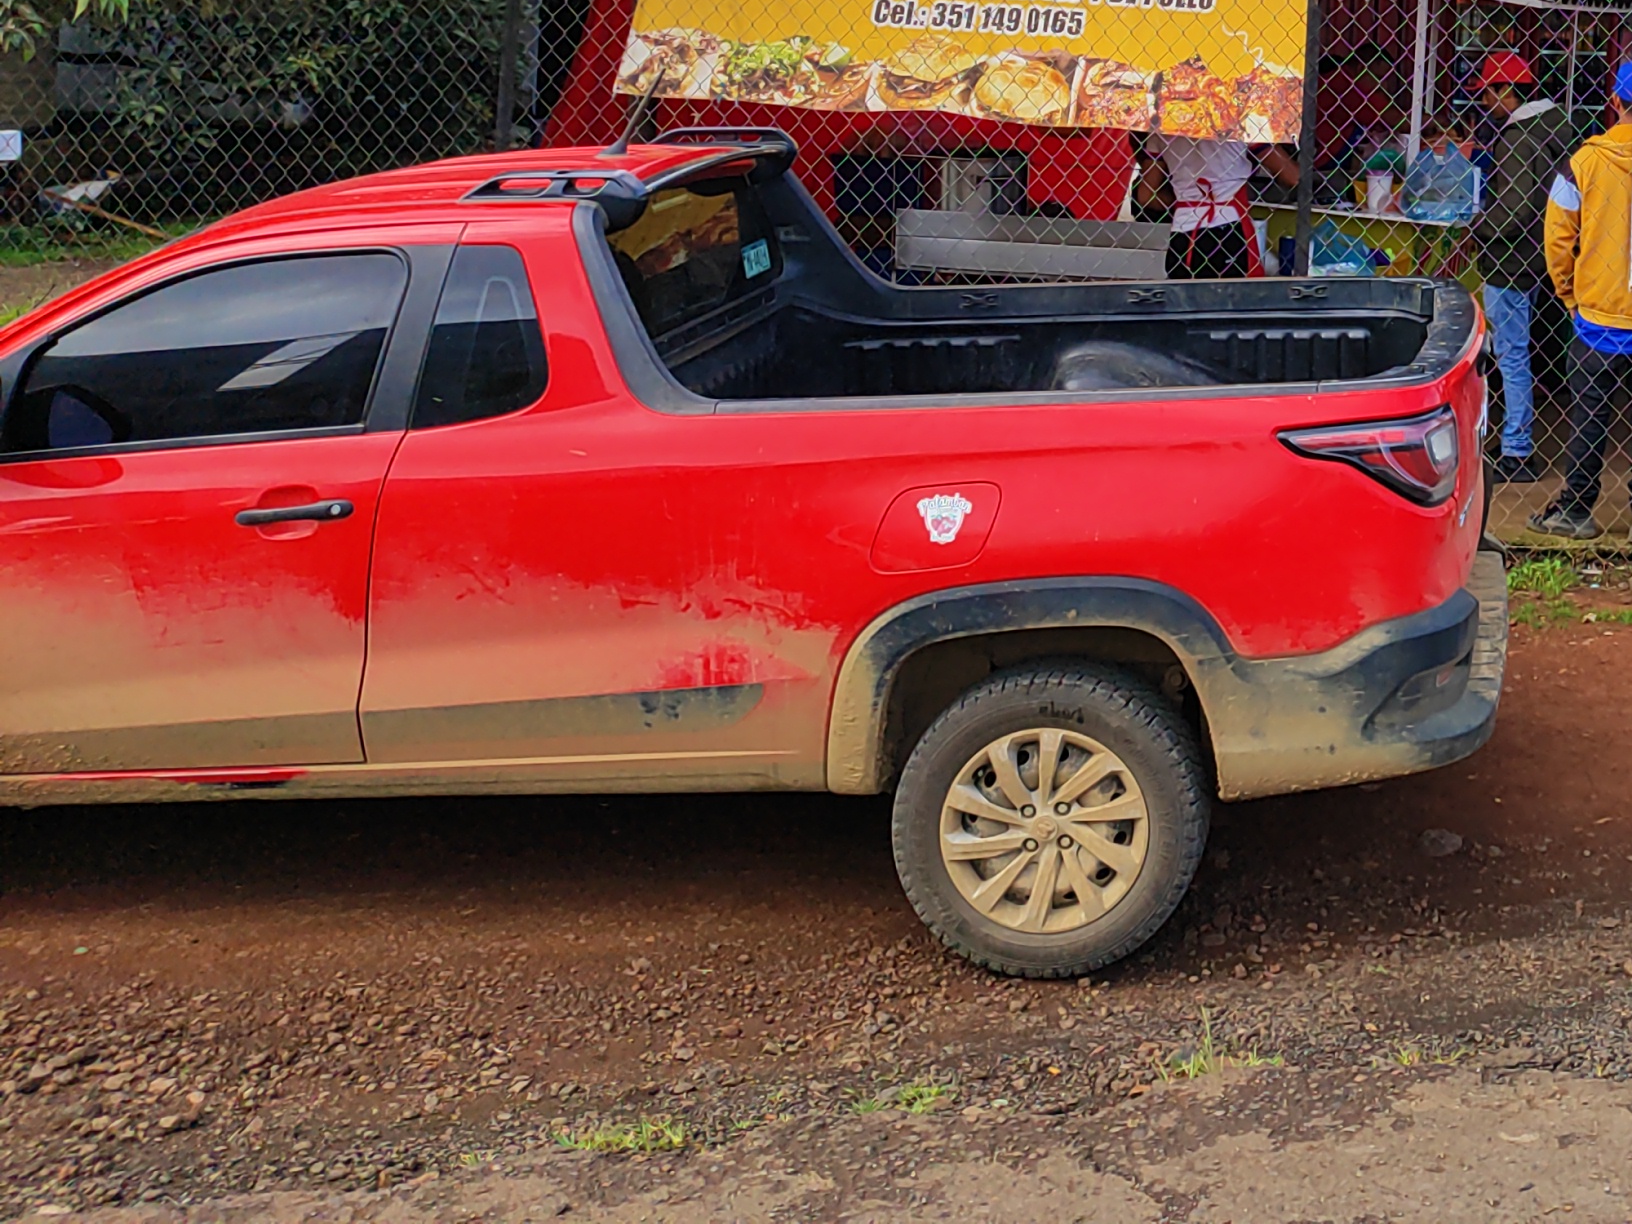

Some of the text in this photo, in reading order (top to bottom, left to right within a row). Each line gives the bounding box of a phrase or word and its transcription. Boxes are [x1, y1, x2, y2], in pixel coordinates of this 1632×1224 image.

[932, 2, 973, 29] 351
[981, 6, 1020, 32] 149
[1027, 8, 1083, 36] 0165
